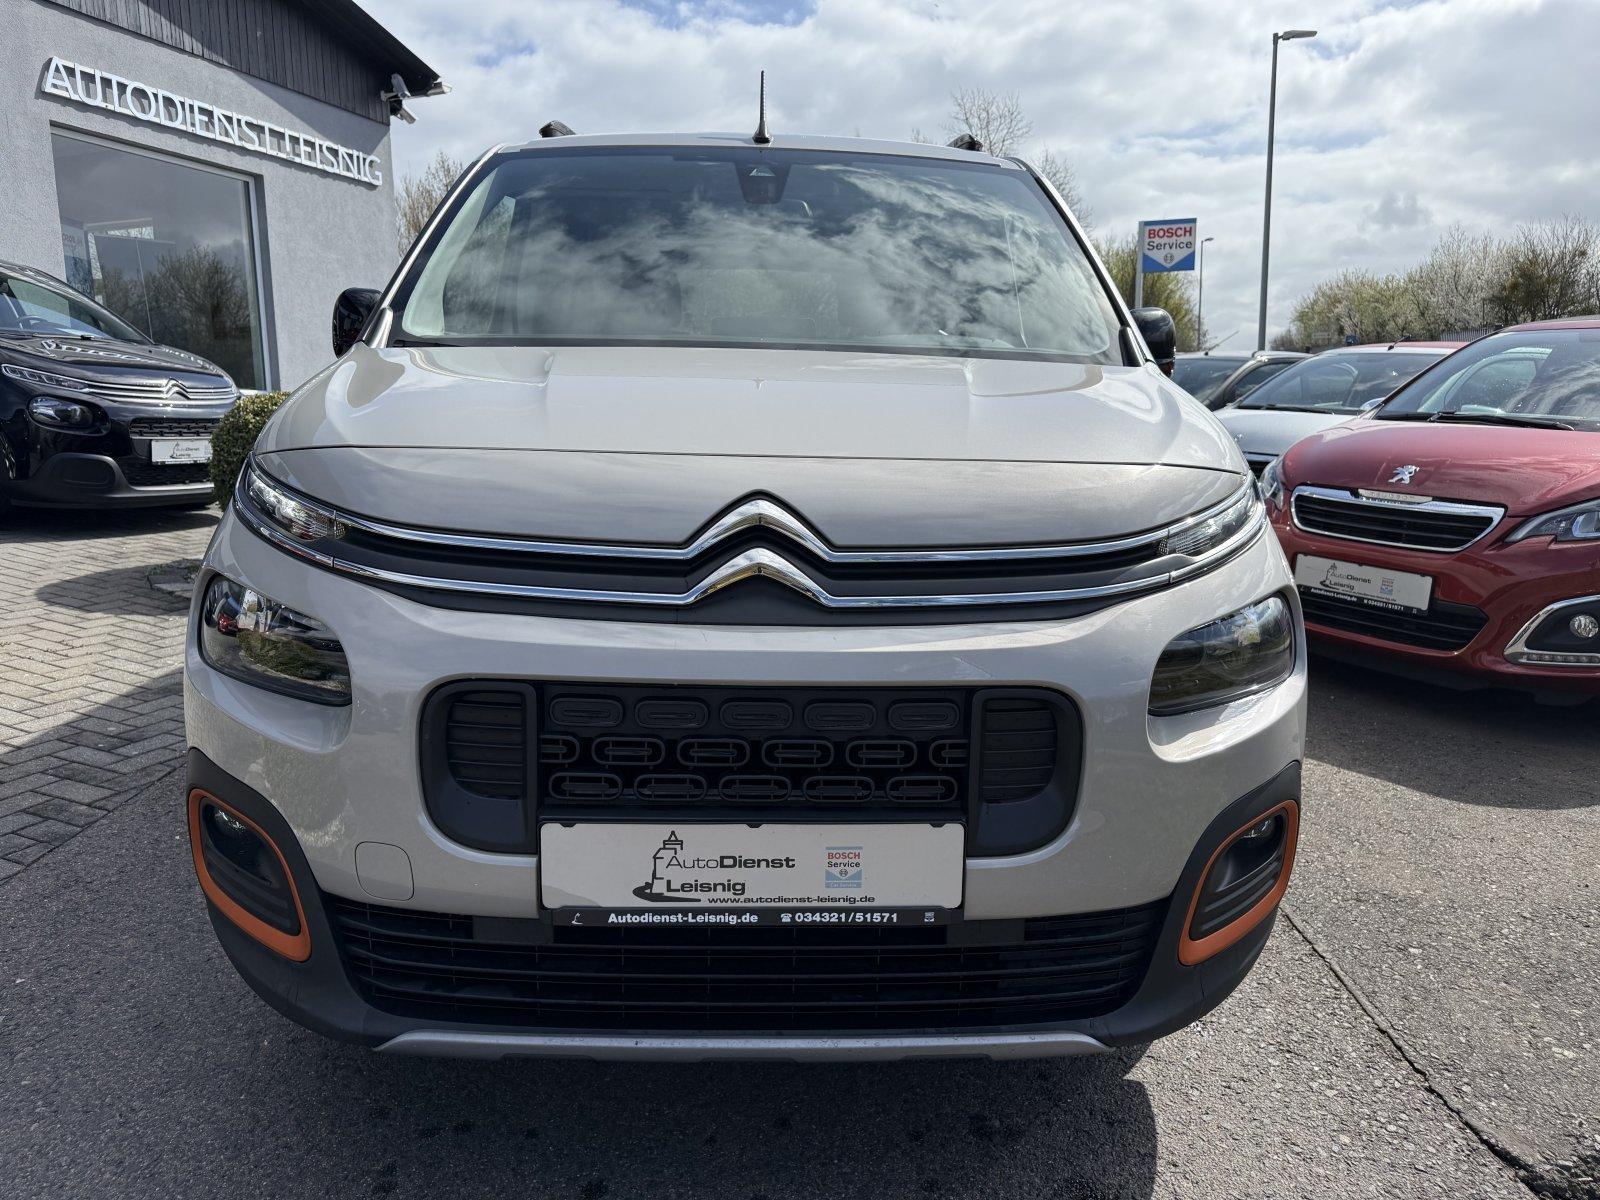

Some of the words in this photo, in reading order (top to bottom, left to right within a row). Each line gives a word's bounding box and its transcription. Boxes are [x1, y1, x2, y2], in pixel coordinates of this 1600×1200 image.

[1148, 226, 1192, 239] BOSCH
[1147, 239, 1192, 251] Service
[665, 855, 796, 869] AutoDienst
[827, 852, 861, 860] BOSCH
[827, 860, 861, 868] Service
[666, 879, 746, 896] Leisnig
[707, 895, 876, 905] www.autodienst-leisnig.de
[607, 912, 759, 925] Autodienst-Leisnig.de
[795, 912, 898, 923] 034321/51571
